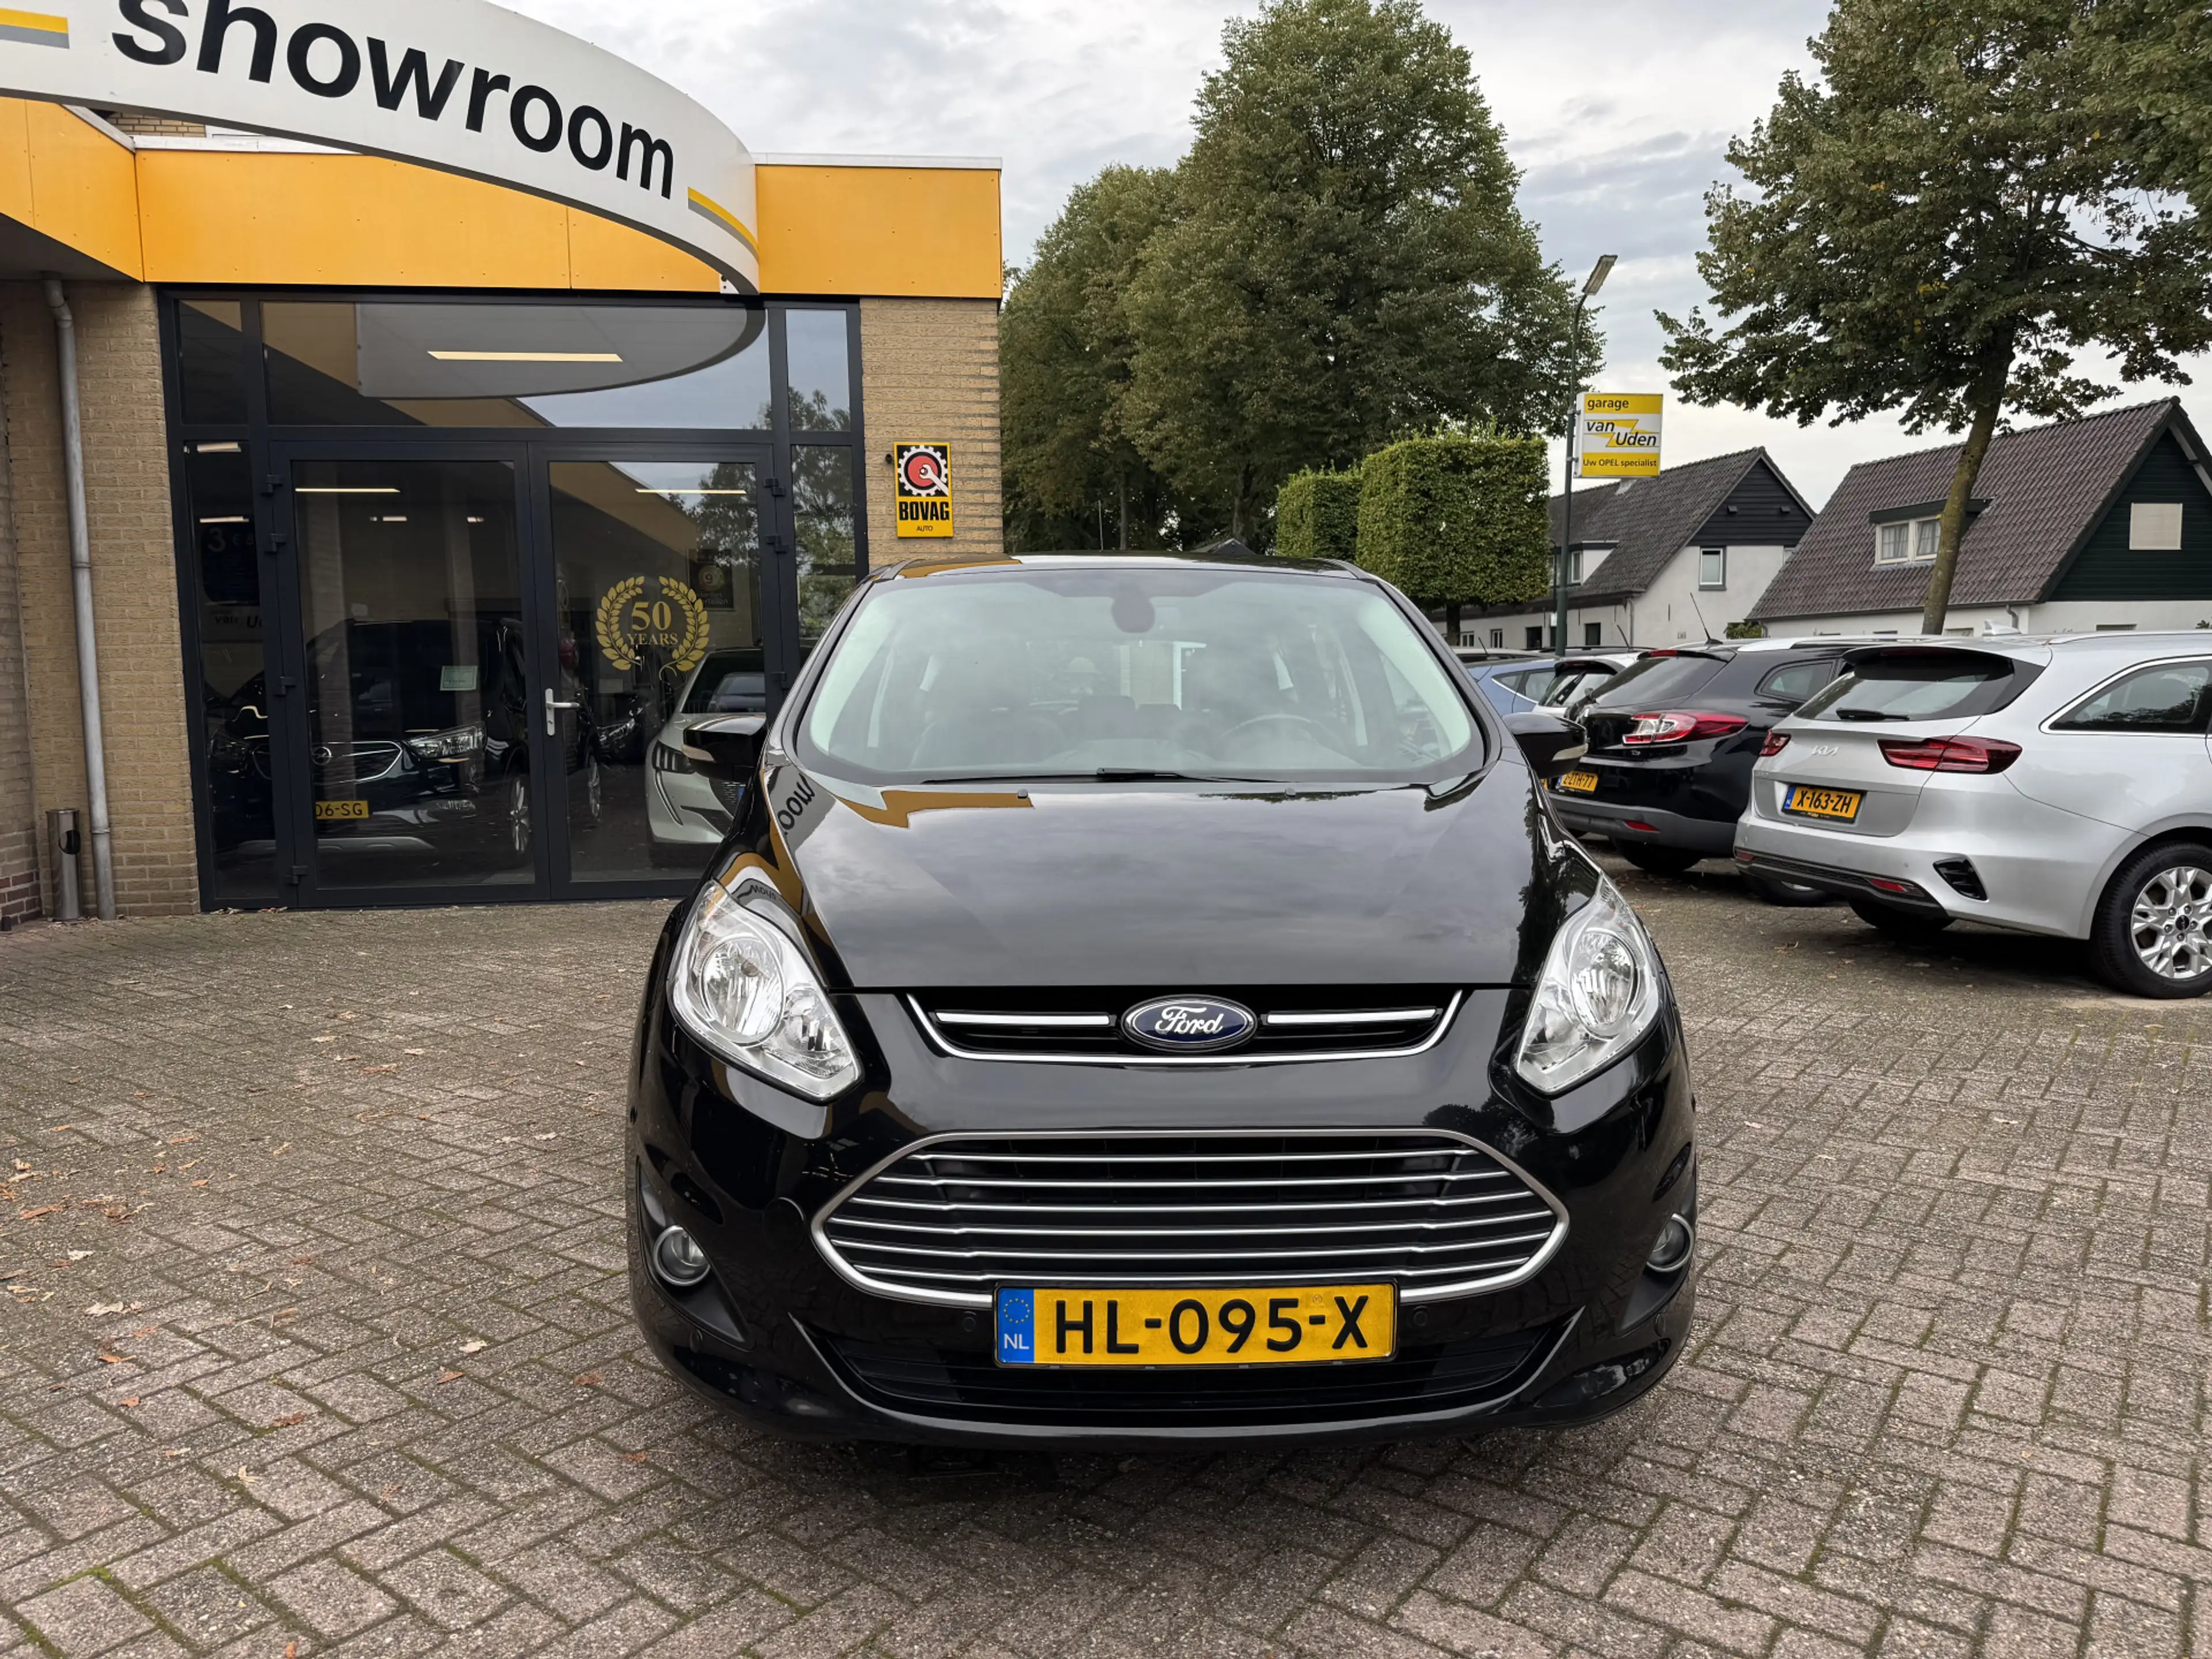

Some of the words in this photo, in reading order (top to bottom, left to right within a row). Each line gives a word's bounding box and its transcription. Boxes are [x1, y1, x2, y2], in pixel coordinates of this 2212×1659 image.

[111, 0, 674, 199] showroom
[1587, 399, 1629, 411] garage
[1586, 421, 1615, 431] van
[1616, 431, 1657, 446] Uden
[1621, 459, 1657, 468] specialist
[899, 501, 950, 521] BOVAG
[631, 601, 671, 631] 50
[626, 632, 679, 645] YEARS
[1797, 790, 1853, 814] X-163-ZH
[1154, 1006, 1224, 1035] Ford
[1003, 1334, 1030, 1350] NL
[1055, 1295, 1370, 1355] HL-095-X
